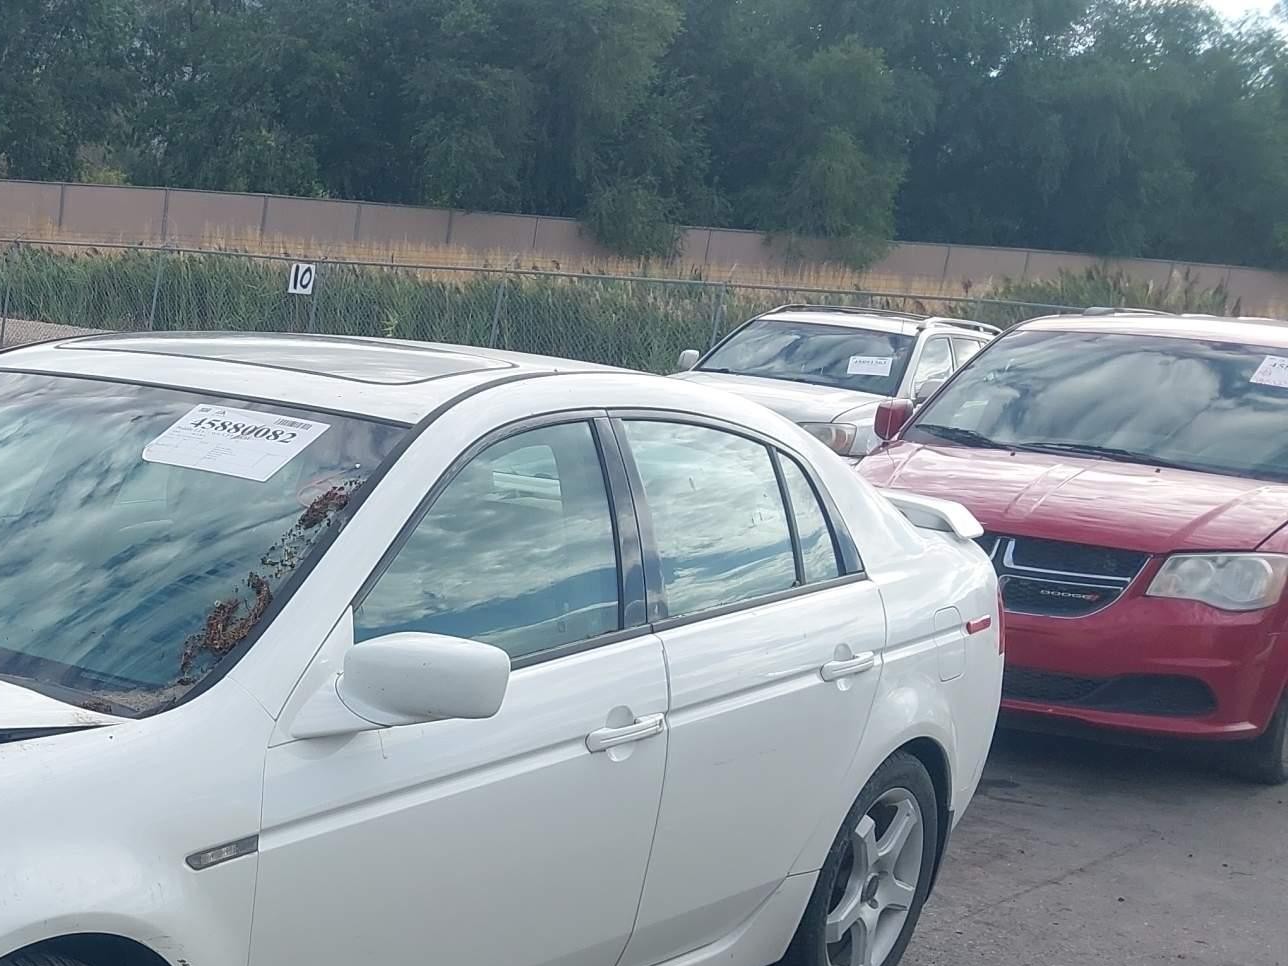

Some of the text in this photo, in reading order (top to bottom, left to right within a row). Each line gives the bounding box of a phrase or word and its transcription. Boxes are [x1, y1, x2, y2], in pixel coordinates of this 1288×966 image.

[293, 263, 313, 290] 10
[190, 417, 298, 444] 45880082
[1039, 589, 1091, 600] DODGE
